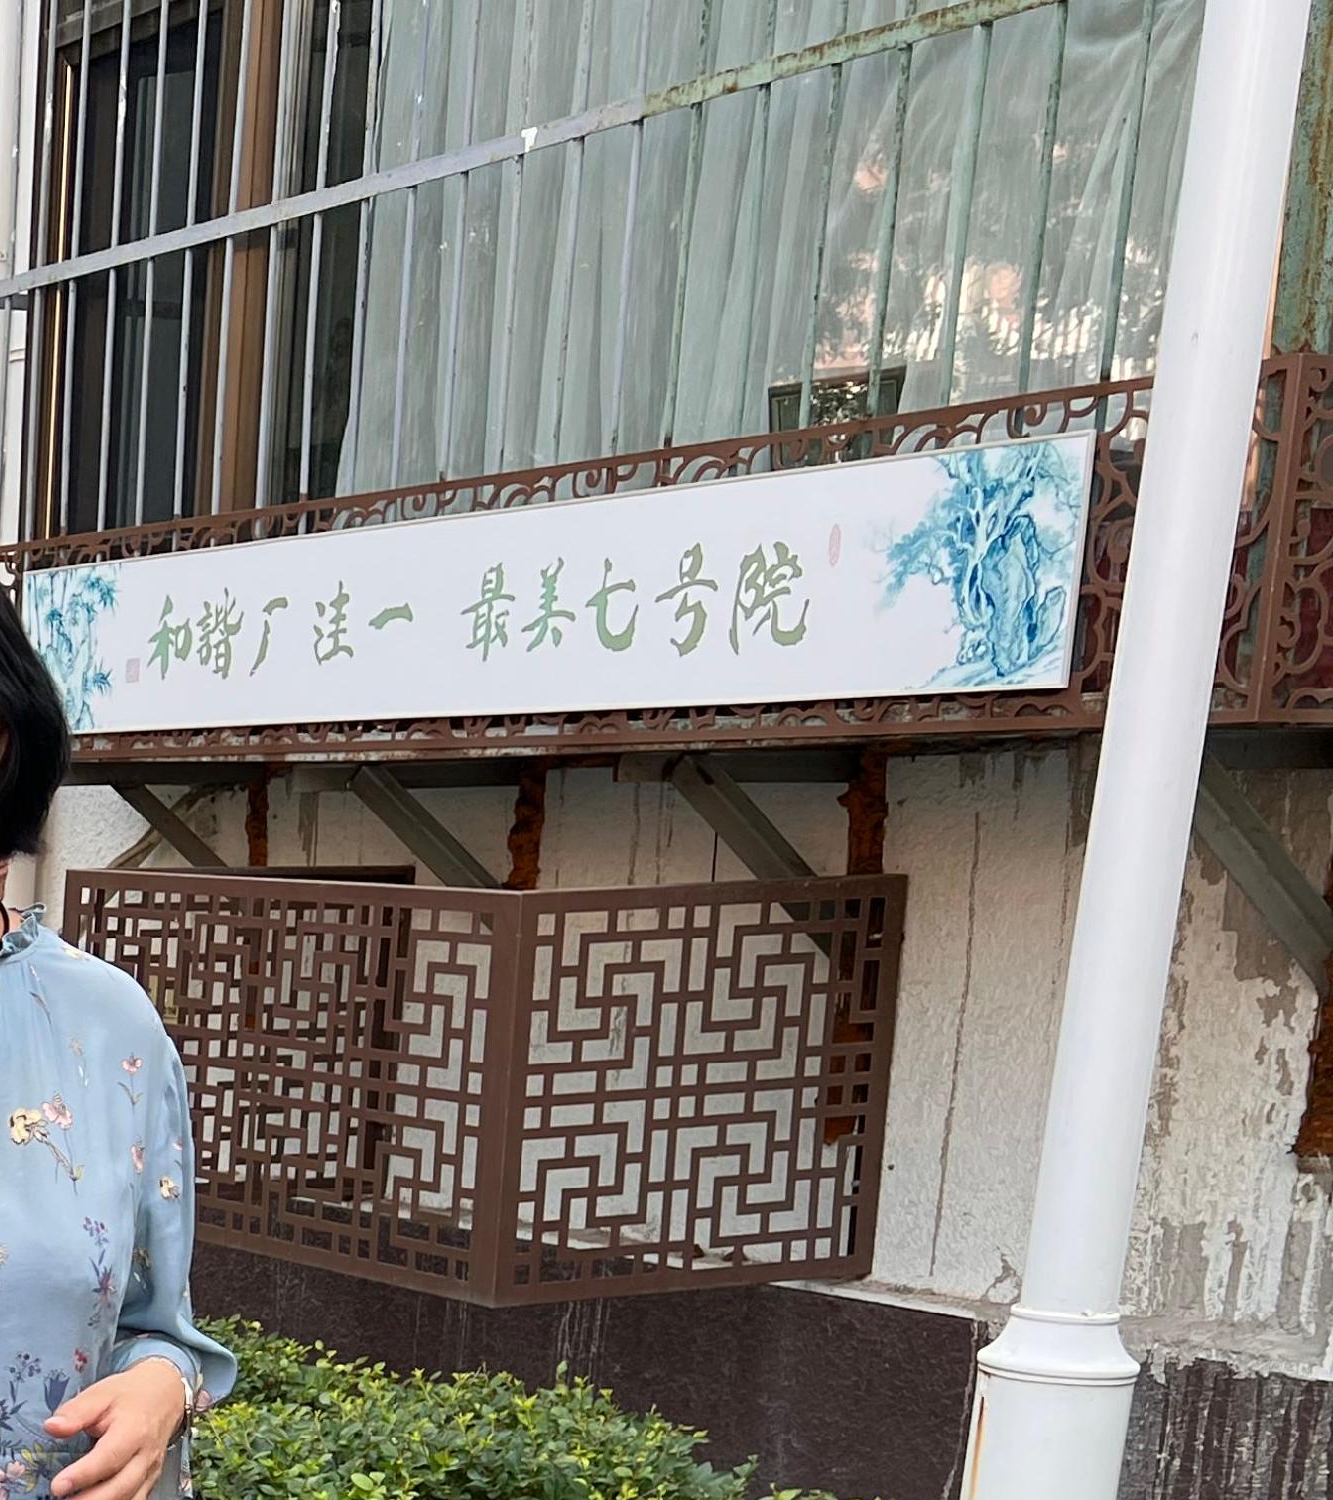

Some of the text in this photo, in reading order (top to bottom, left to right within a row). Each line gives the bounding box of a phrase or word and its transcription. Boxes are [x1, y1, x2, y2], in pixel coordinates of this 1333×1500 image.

[460, 541, 811, 662] 最美七号院
